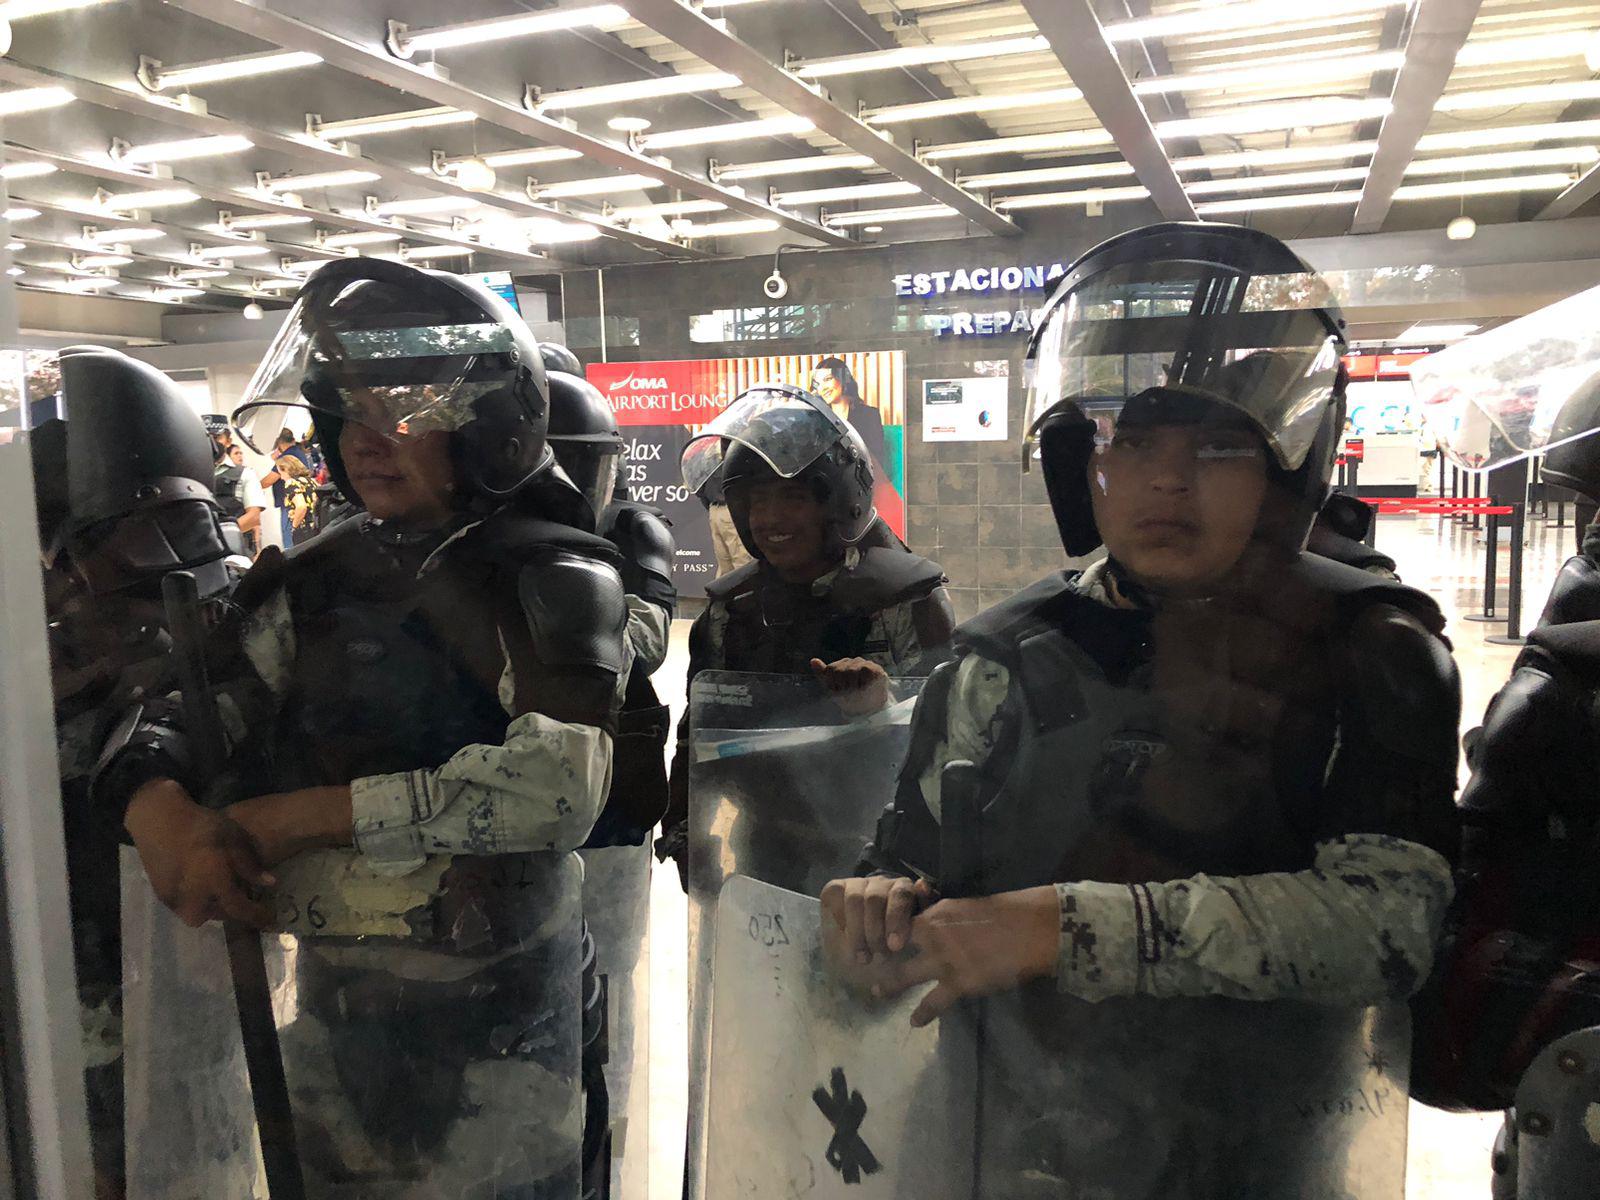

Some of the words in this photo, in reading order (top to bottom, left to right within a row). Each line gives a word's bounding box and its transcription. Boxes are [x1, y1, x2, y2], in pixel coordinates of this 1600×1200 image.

[894, 263, 1074, 296] ESTACIONA
[629, 377, 668, 390] OMA
[606, 393, 669, 413] AIRPORT
[671, 391, 729, 412] LOUNG
[622, 438, 663, 461] elax
[625, 464, 648, 481] as
[628, 485, 664, 502] ver
[665, 485, 690, 502] so
